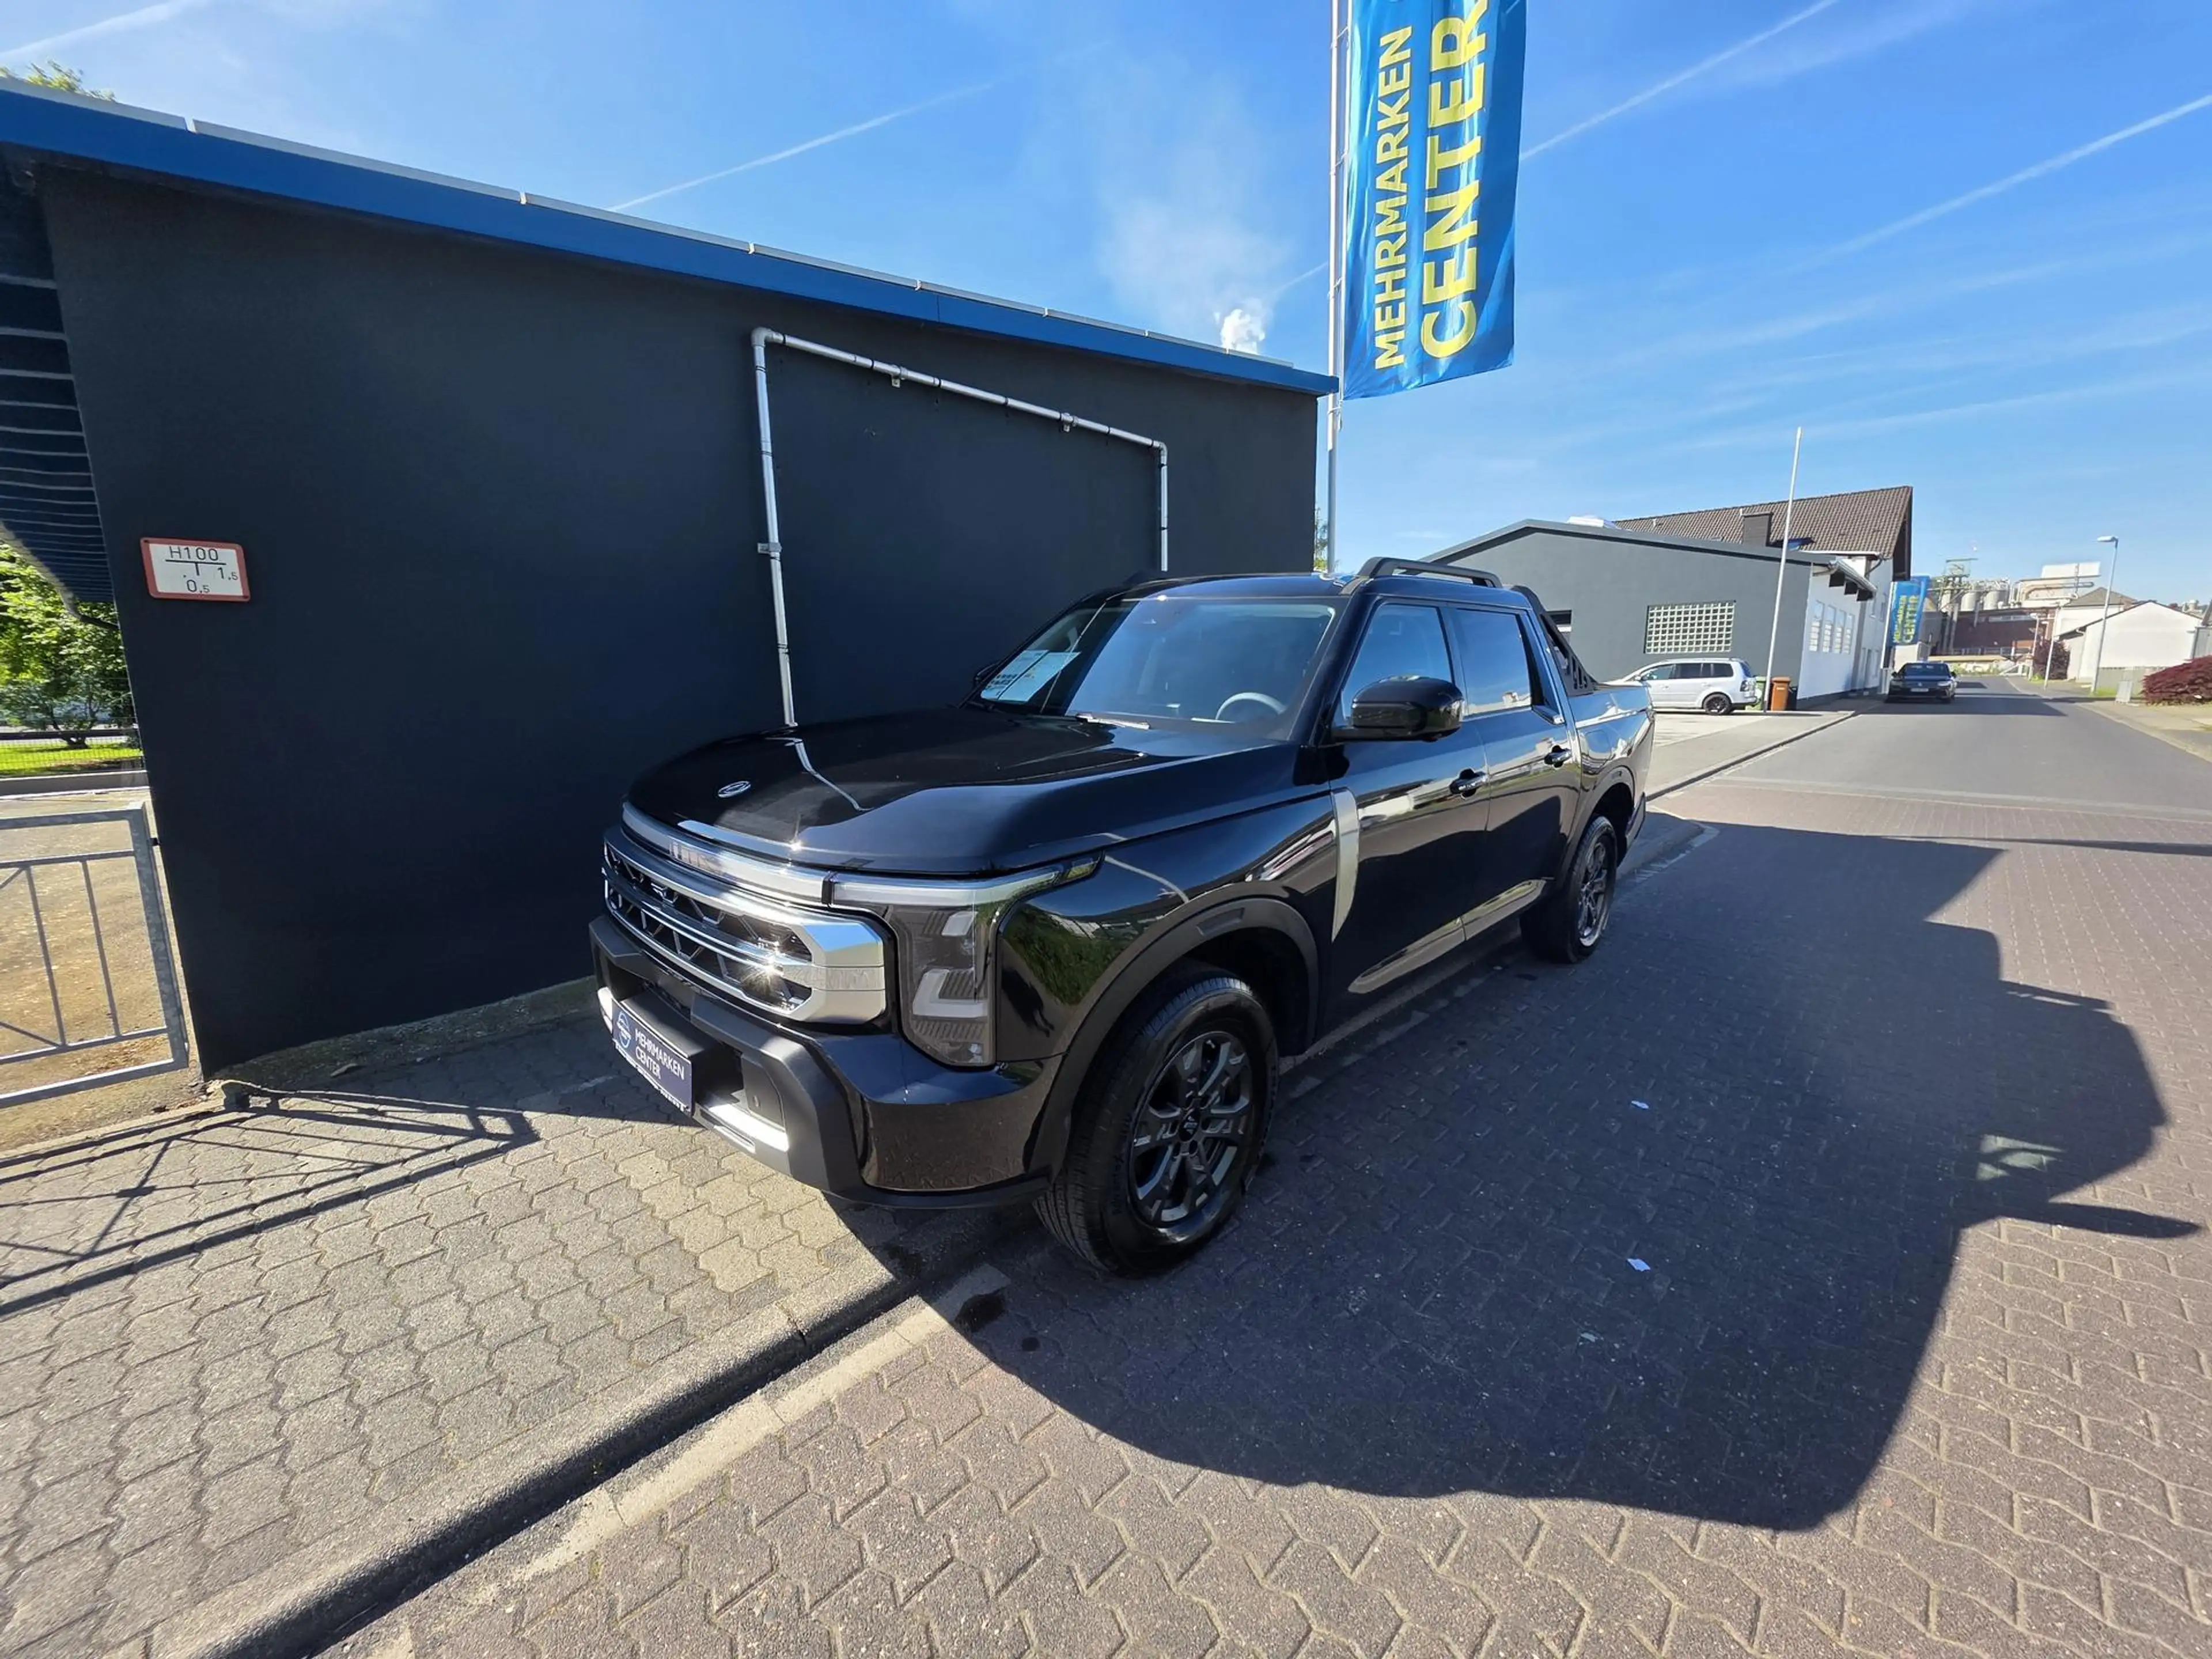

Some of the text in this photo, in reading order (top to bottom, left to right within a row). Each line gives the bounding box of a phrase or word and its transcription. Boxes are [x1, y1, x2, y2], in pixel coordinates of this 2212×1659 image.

[1373, 25, 1412, 369] MEHRMARKEN
[1421, 0, 1488, 359] CENTER
[169, 546, 219, 561] H100
[1903, 595, 1918, 643] CENTER
[635, 1028, 684, 1080] MEHRMARKEN
[635, 1047, 661, 1079] CENTER
